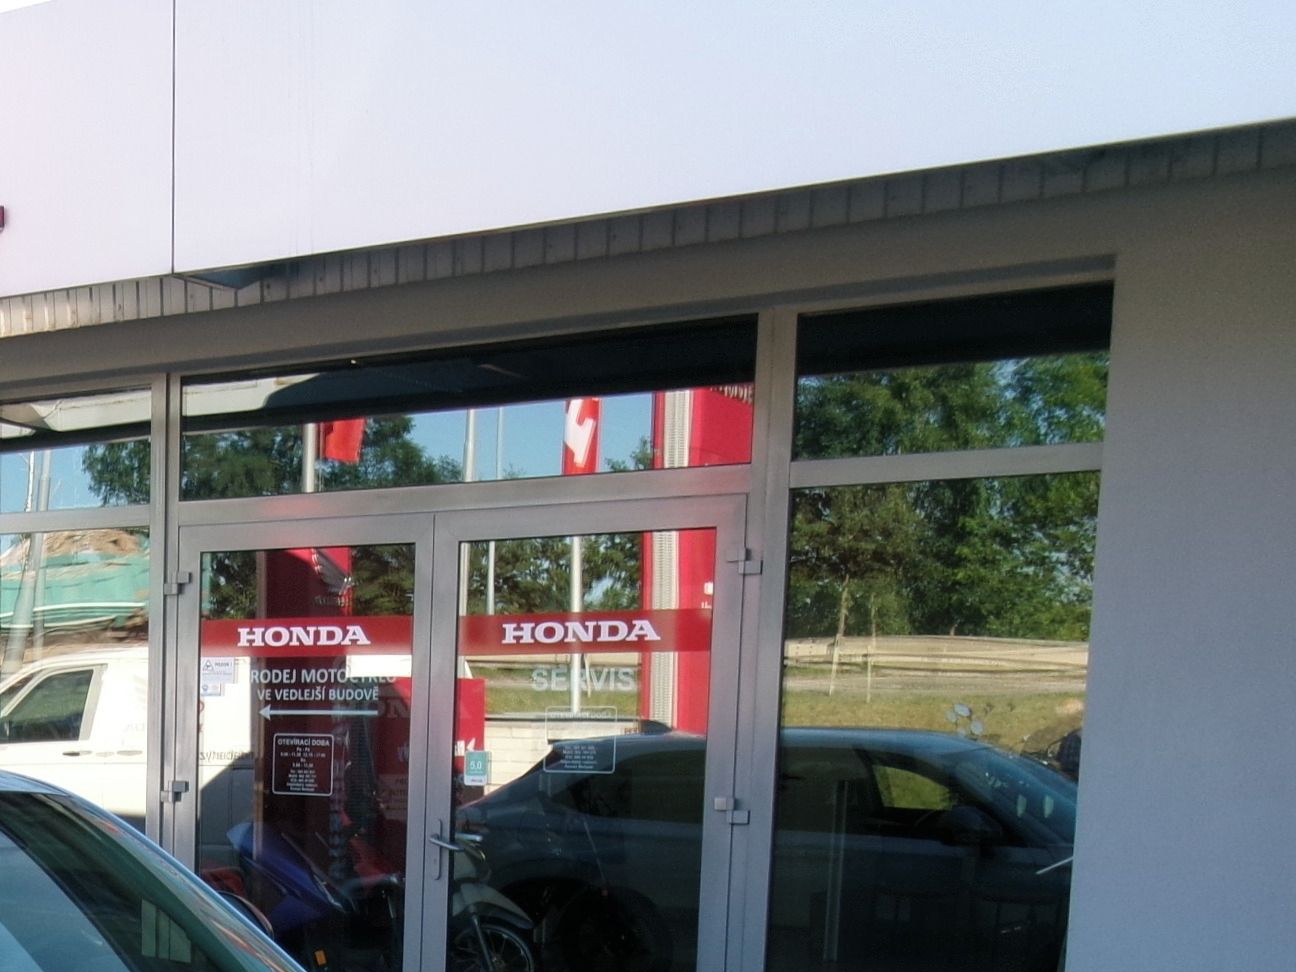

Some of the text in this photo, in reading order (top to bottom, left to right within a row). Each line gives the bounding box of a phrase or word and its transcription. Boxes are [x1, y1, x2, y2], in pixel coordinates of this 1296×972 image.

[237, 625, 372, 647] HONDA
[501, 619, 662, 644] HONDA
[250, 668, 297, 684] RODEJ
[257, 686, 380, 701] VE VEDLEJŠÍ BUDOVĚ
